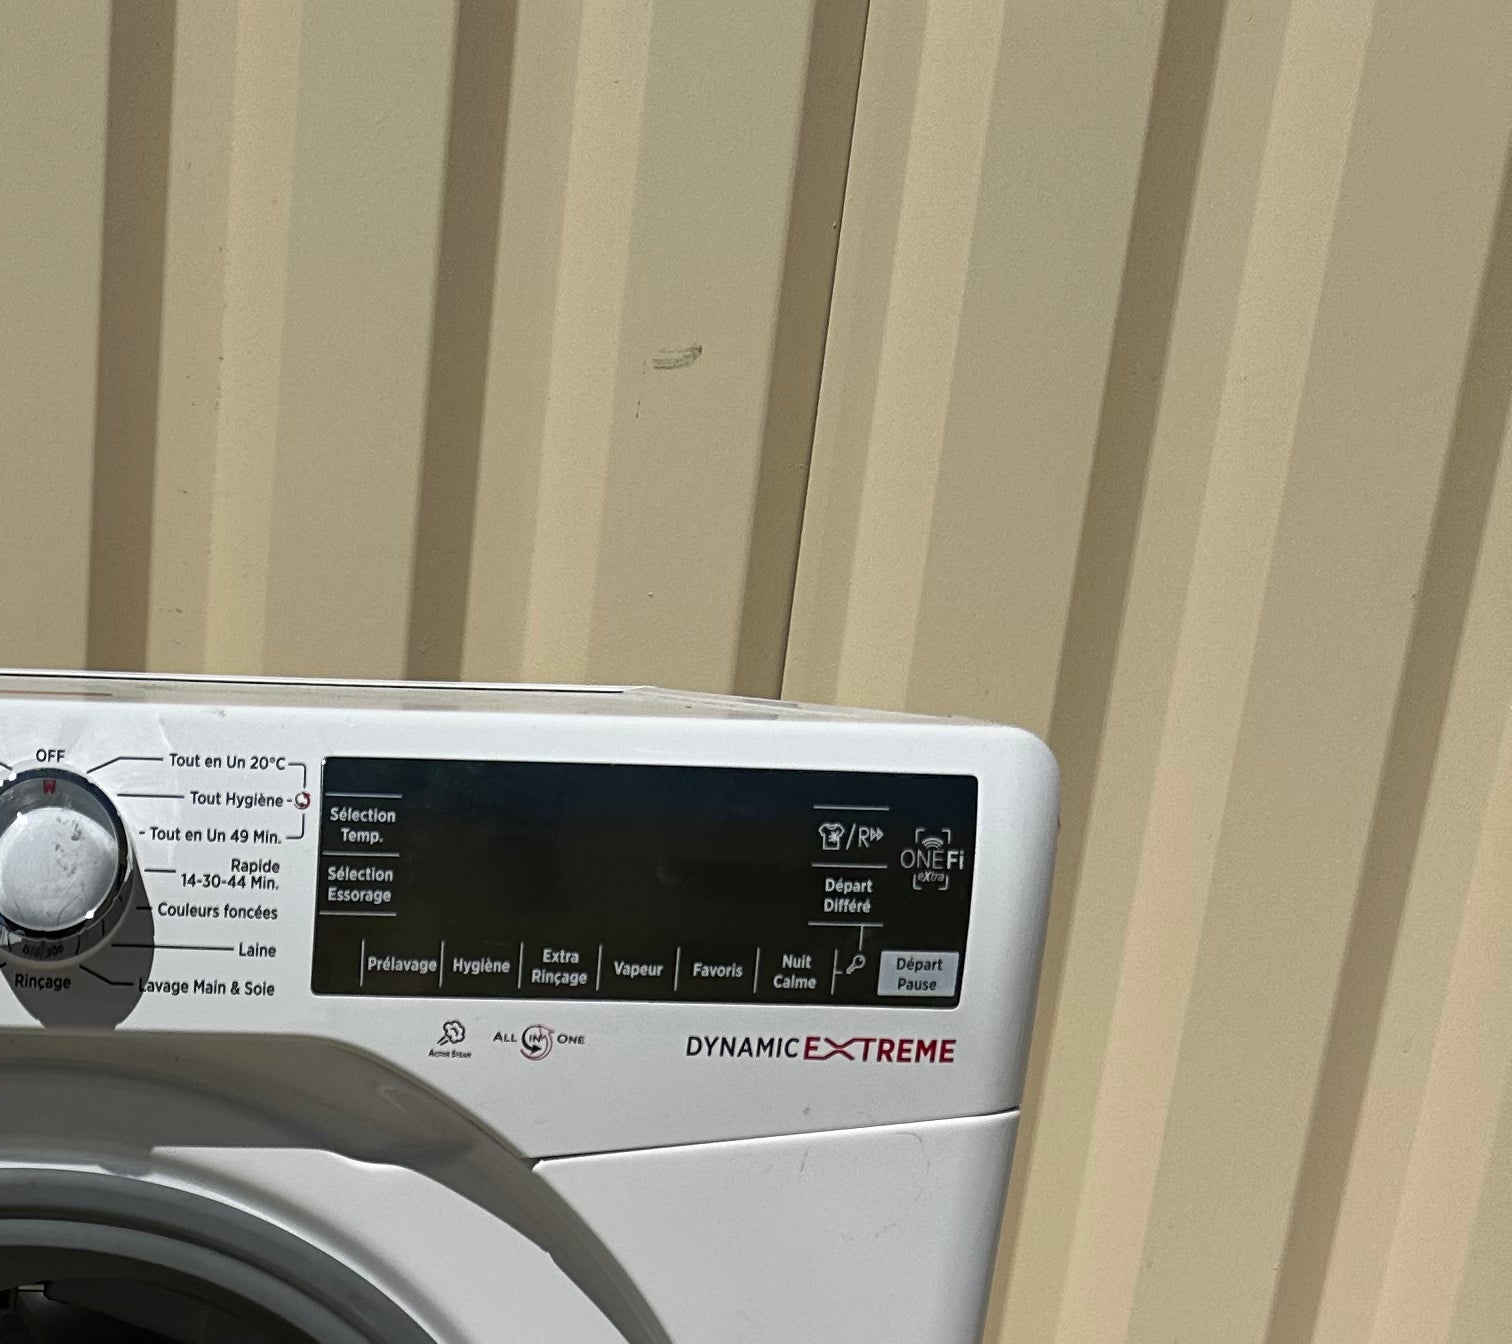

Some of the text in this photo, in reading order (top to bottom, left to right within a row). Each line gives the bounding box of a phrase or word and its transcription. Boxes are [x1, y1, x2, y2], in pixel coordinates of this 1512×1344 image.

[36, 749, 65, 764] OFF
[169, 752, 286, 771] Tout en Un 20°C
[191, 792, 283, 809] Tout Hygiène
[330, 807, 395, 824] Sélection
[151, 826, 281, 844] Tout en Un 49 Min.
[341, 827, 383, 845] Temp.
[231, 859, 280, 877] Rapide
[327, 866, 393, 882] Sélection
[181, 874, 280, 890] 14-30-44 Min.
[825, 878, 873, 894] Départ
[327, 886, 391, 904] Essorage
[158, 902, 278, 920] Couleurs foncées
[824, 898, 870, 913] Différé
[240, 943, 276, 958] Laine
[543, 949, 579, 965] Extra
[368, 956, 437, 974] Prélavage
[452, 956, 510, 976] Hygiène
[614, 961, 663, 979] Vapeur
[693, 961, 742, 979] Favoris
[782, 953, 811, 970] Nuit
[897, 956, 943, 975] Départ
[15, 973, 71, 991] Rinçage
[532, 969, 588, 987] Rinçage
[773, 972, 816, 990] Calme
[898, 976, 936, 992] Pause
[139, 979, 274, 997] Lavage Main & Soie
[493, 1032, 517, 1043] ALL
[557, 1034, 585, 1045] ONE
[686, 1035, 956, 1064] DYNAMIC EXTREME
